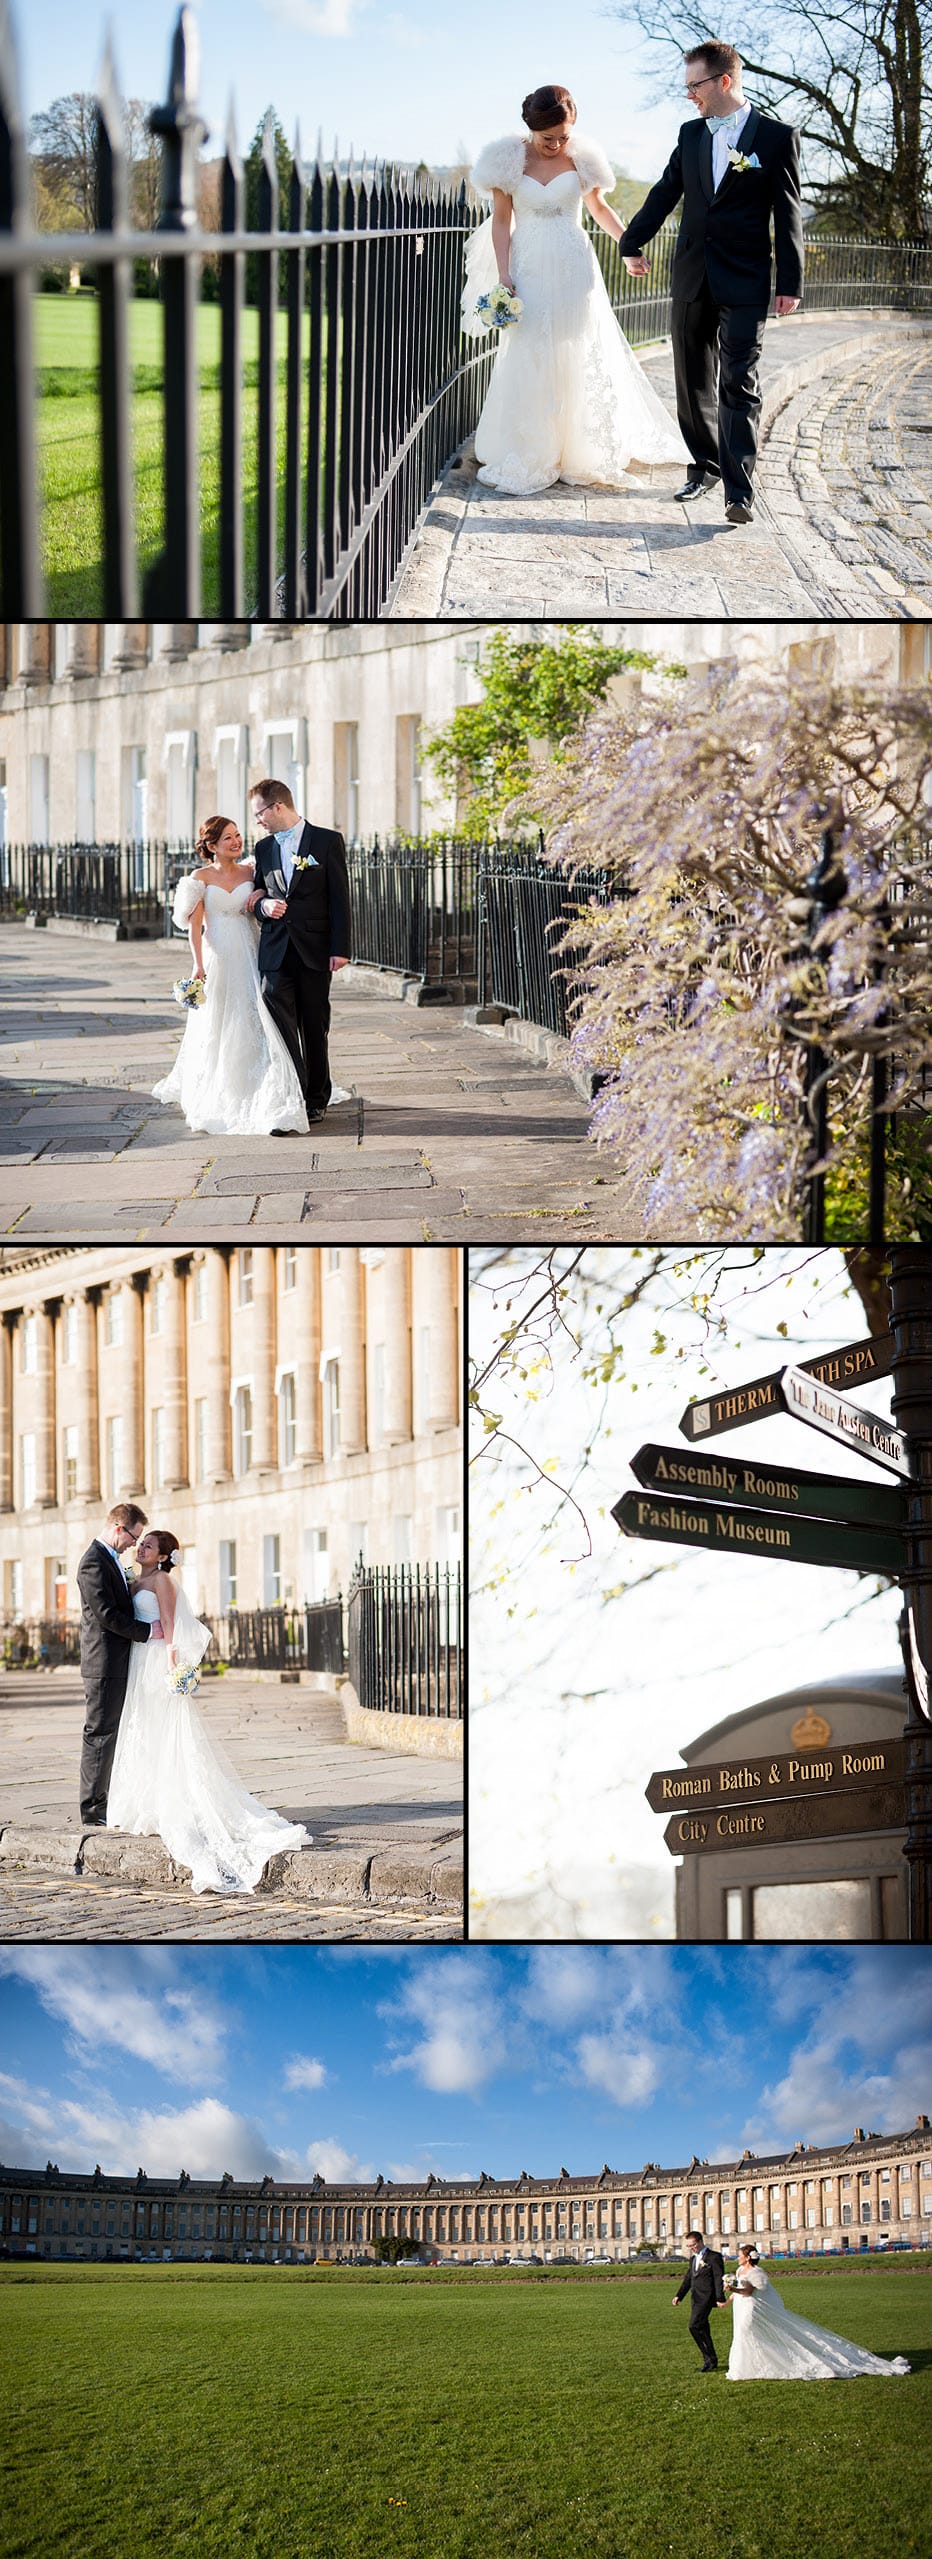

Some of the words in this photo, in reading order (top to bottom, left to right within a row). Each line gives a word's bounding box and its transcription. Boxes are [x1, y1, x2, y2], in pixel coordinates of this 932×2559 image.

[715, 1384, 776, 1421] THERM
[844, 1348, 876, 1377] SPA
[837, 1405, 871, 1444] Austen
[872, 1425, 902, 1461] Centre
[655, 1456, 737, 1494] Assembly
[744, 1470, 799, 1500] Rooms
[637, 1502, 709, 1534] Fashion
[716, 1513, 791, 1546] Museum
[662, 1778, 712, 1799] Roman
[719, 1767, 761, 1792] Baths
[768, 1763, 782, 1784] &
[788, 1760, 834, 1782] Pump
[841, 1754, 885, 1775] Room
[678, 1820, 710, 1843] City
[717, 1815, 765, 1836] Centre
